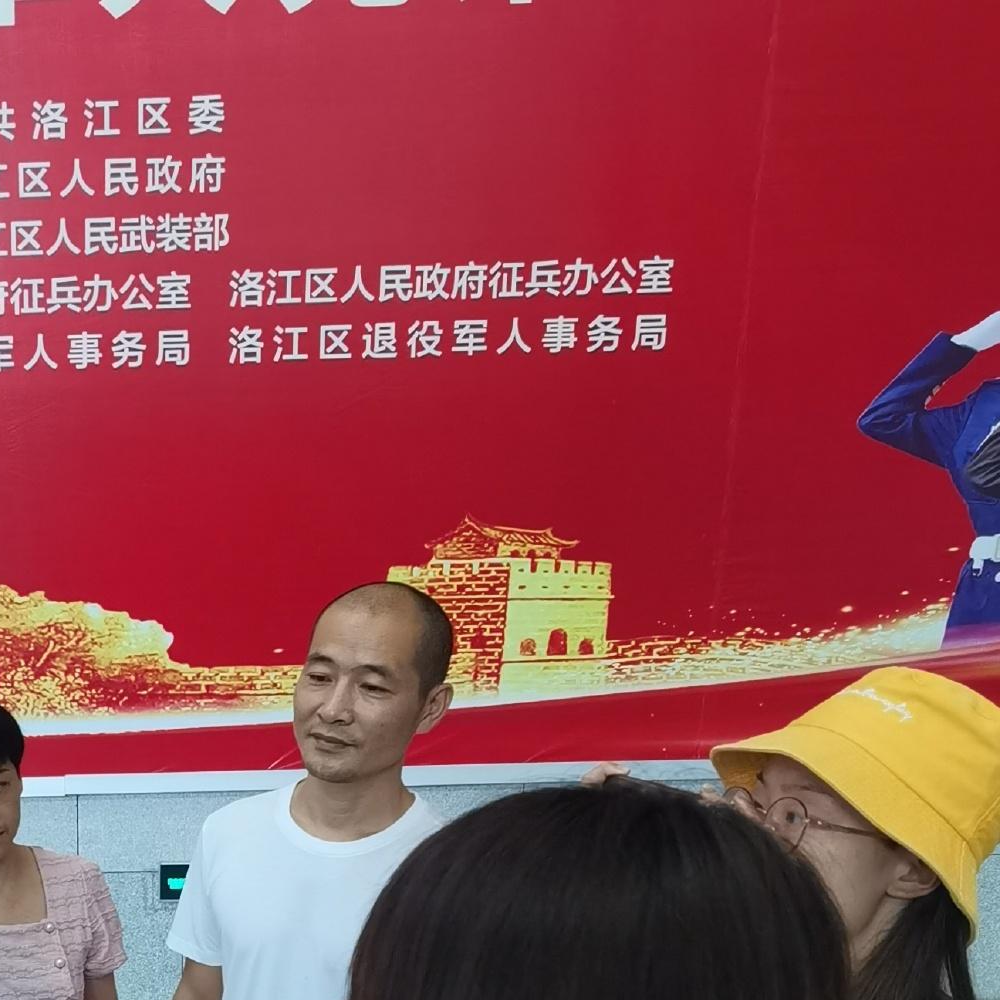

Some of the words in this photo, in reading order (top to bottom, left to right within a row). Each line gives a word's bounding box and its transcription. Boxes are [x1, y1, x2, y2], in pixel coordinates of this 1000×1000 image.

[229, 255, 674, 308] 洛江区人民政府征兵办公室
[228, 314, 667, 364] 洛江区退役军人事务局
